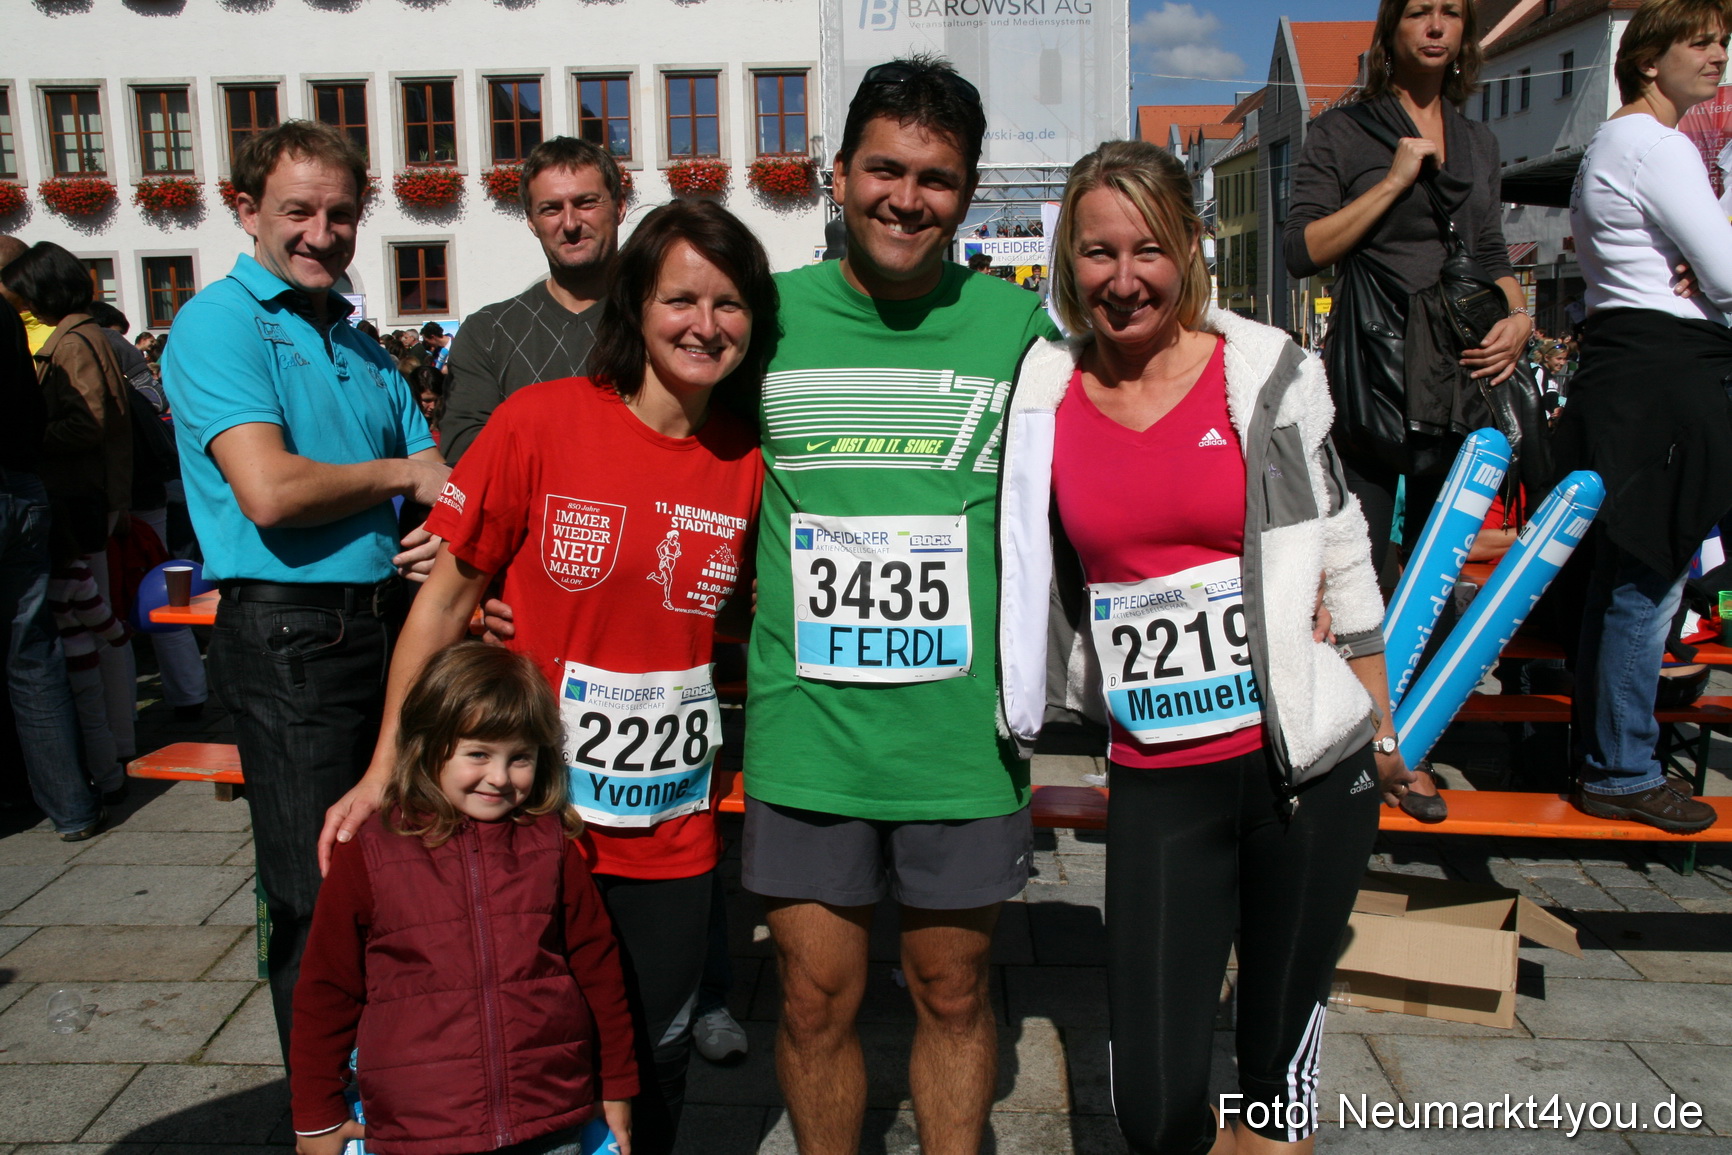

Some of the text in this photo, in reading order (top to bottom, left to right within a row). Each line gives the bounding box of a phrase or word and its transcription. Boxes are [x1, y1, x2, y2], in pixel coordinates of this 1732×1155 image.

[907, 0, 1092, 17] BAROWSKI AG
[909, 18, 1091, 29] Veranstaltungs- und Mediensysteme
[831, 438, 864, 453] JUST
[865, 438, 884, 453] DO
[885, 438, 900, 453] IT.
[904, 438, 944, 454] SINCE
[1198, 438, 1228, 448] adidas
[567, 502, 601, 513] 850 Jahre
[655, 501, 748, 531] 11. NEUMARKTER
[556, 509, 611, 529] IMMER
[671, 516, 735, 540] STADTLAUF
[552, 523, 611, 544] WIEDER
[816, 528, 890, 546] PFLEIDERER
[910, 534, 952, 546] BOCK
[550, 538, 605, 565] NEU
[815, 544, 890, 554] AKTIENGESELLSCHAFT
[549, 559, 601, 579] MARKT
[809, 557, 950, 621] 3435
[1112, 588, 1186, 611] PFLEIDERER
[1111, 601, 1189, 621] AKTIENGESELLSCHAFT
[829, 626, 958, 667] FERDL
[1112, 603, 1253, 683] 2219
[588, 682, 666, 702] PFLEIDERER
[681, 683, 714, 700] BOCK
[1109, 676, 1117, 688] D
[588, 698, 666, 711] AKTIENGESELLSCHAFT
[1127, 674, 1264, 722] Manuela
[575, 708, 710, 772] 2228
[588, 772, 690, 808] Yvonne
[1350, 780, 1375, 795] adidas
